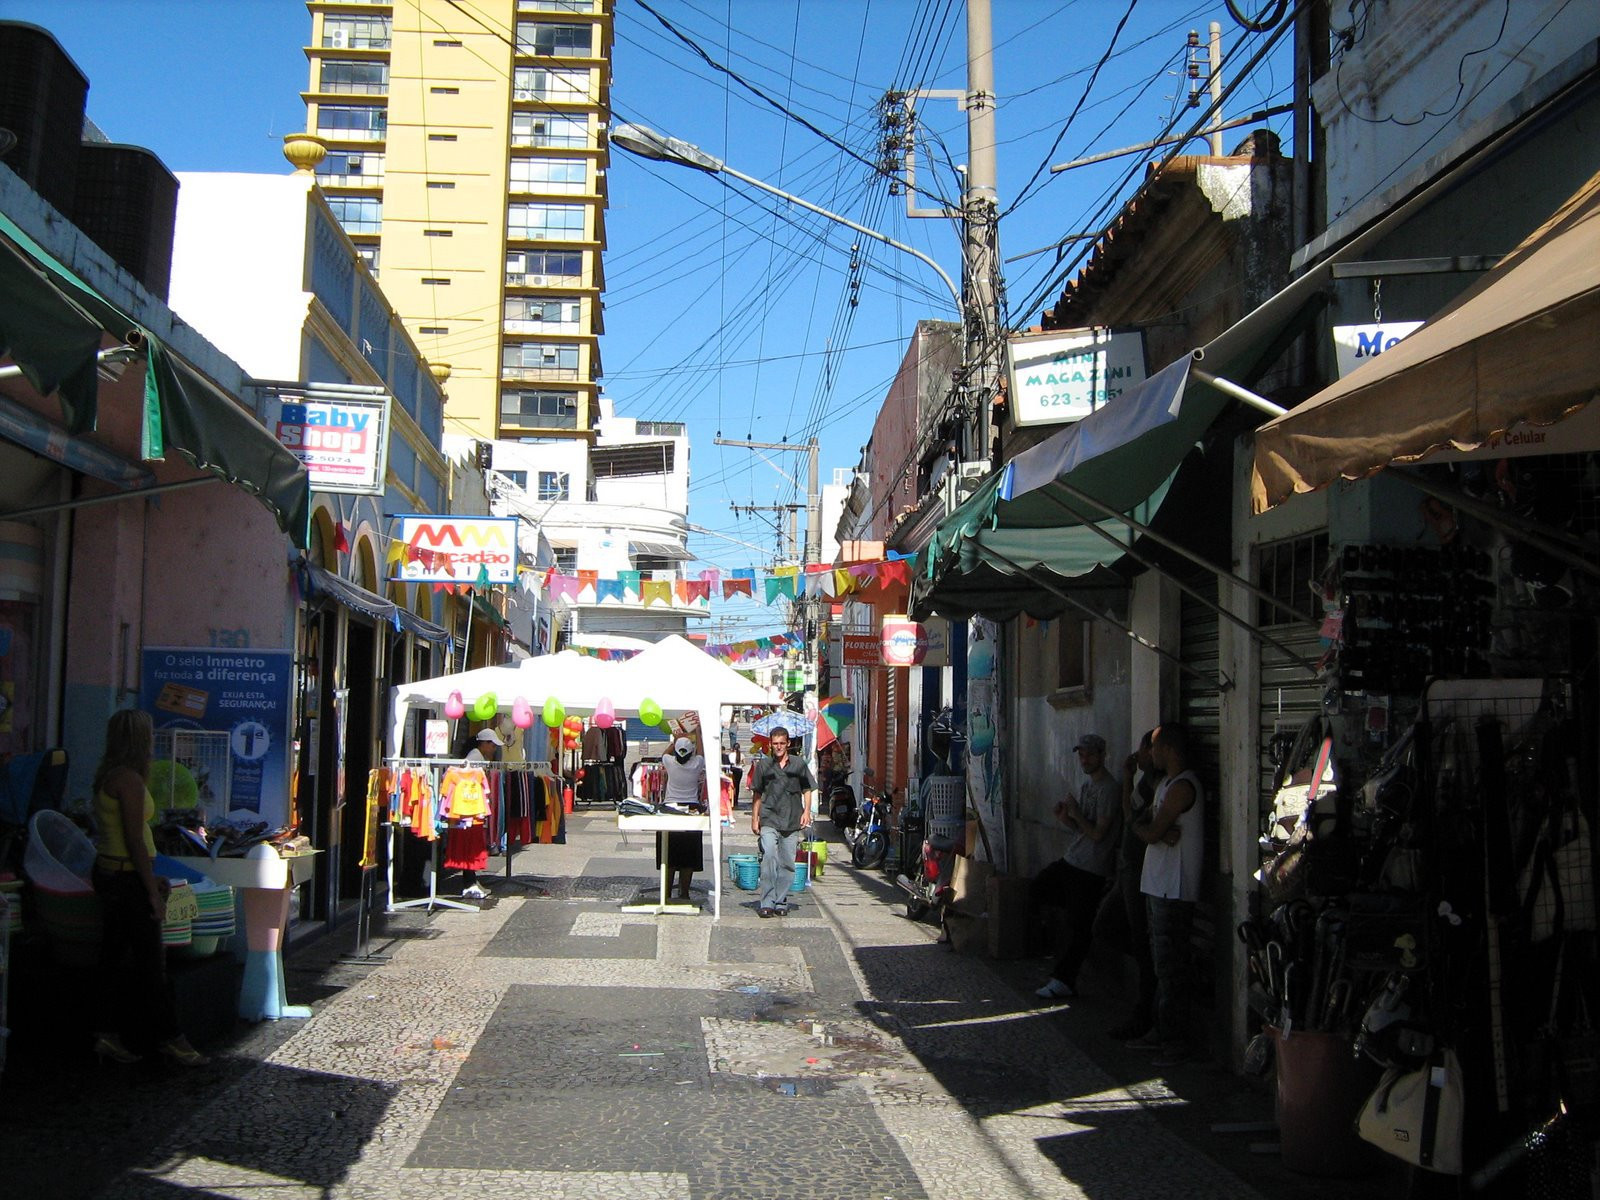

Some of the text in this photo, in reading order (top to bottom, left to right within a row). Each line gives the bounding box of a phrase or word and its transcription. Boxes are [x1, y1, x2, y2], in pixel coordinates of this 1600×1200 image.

[281, 404, 370, 432] Baby
[279, 424, 362, 453] Shop
[1504, 431, 1546, 446] Celular
[165, 655, 265, 668] O selo Inmetro
[154, 668, 276, 684] faz toda a diferença
[223, 690, 265, 699] EXIJA ESTA
[219, 699, 276, 710] SEGURANÇA!
